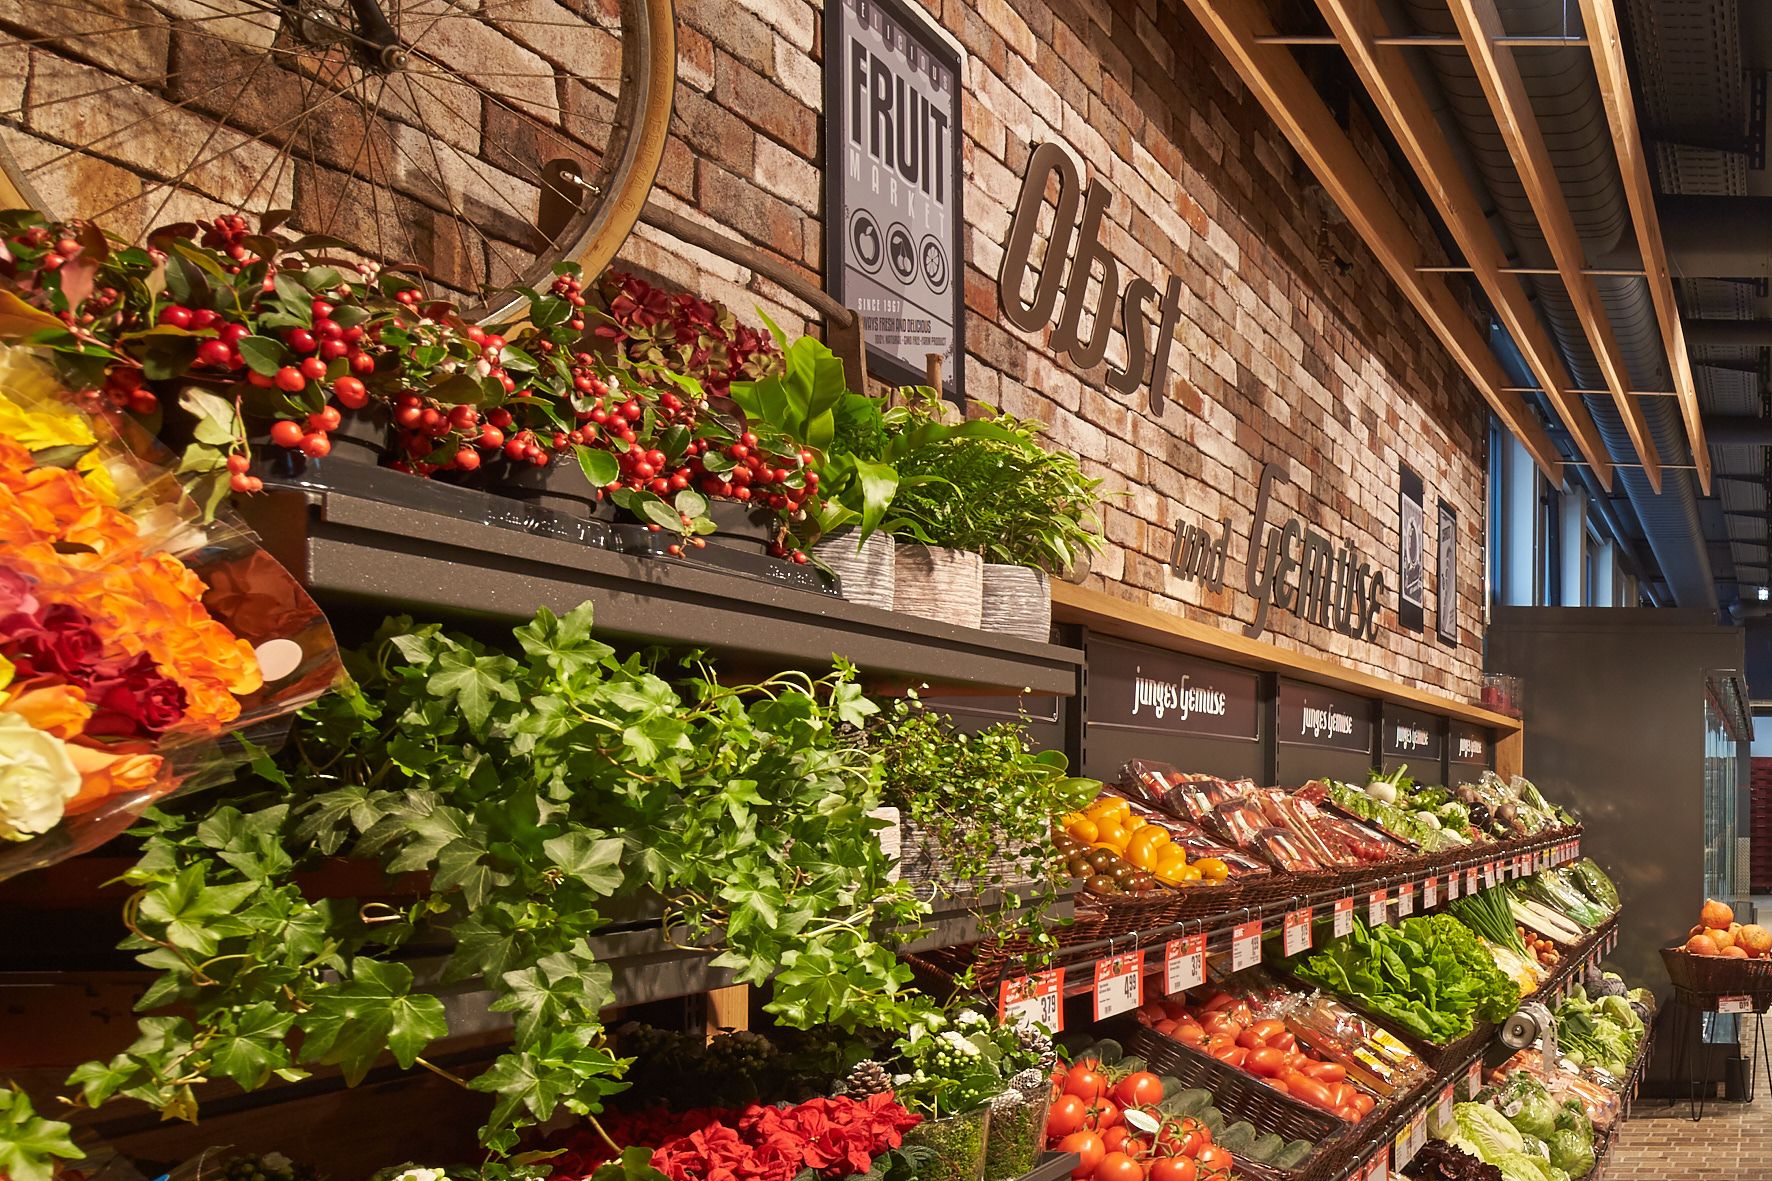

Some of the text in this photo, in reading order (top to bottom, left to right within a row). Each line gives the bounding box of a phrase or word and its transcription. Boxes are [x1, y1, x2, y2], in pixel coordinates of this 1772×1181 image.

[850, 36, 948, 206] FRUIT
[850, 150, 945, 239] MARKET
[858, 298, 900, 313] SINCE 1967
[1000, 142, 1182, 418] Obst
[1170, 462, 1385, 643] und Gemüse
[1132, 665, 1226, 721] junges Gemüse
[1301, 699, 1353, 739] junges Gemüse
